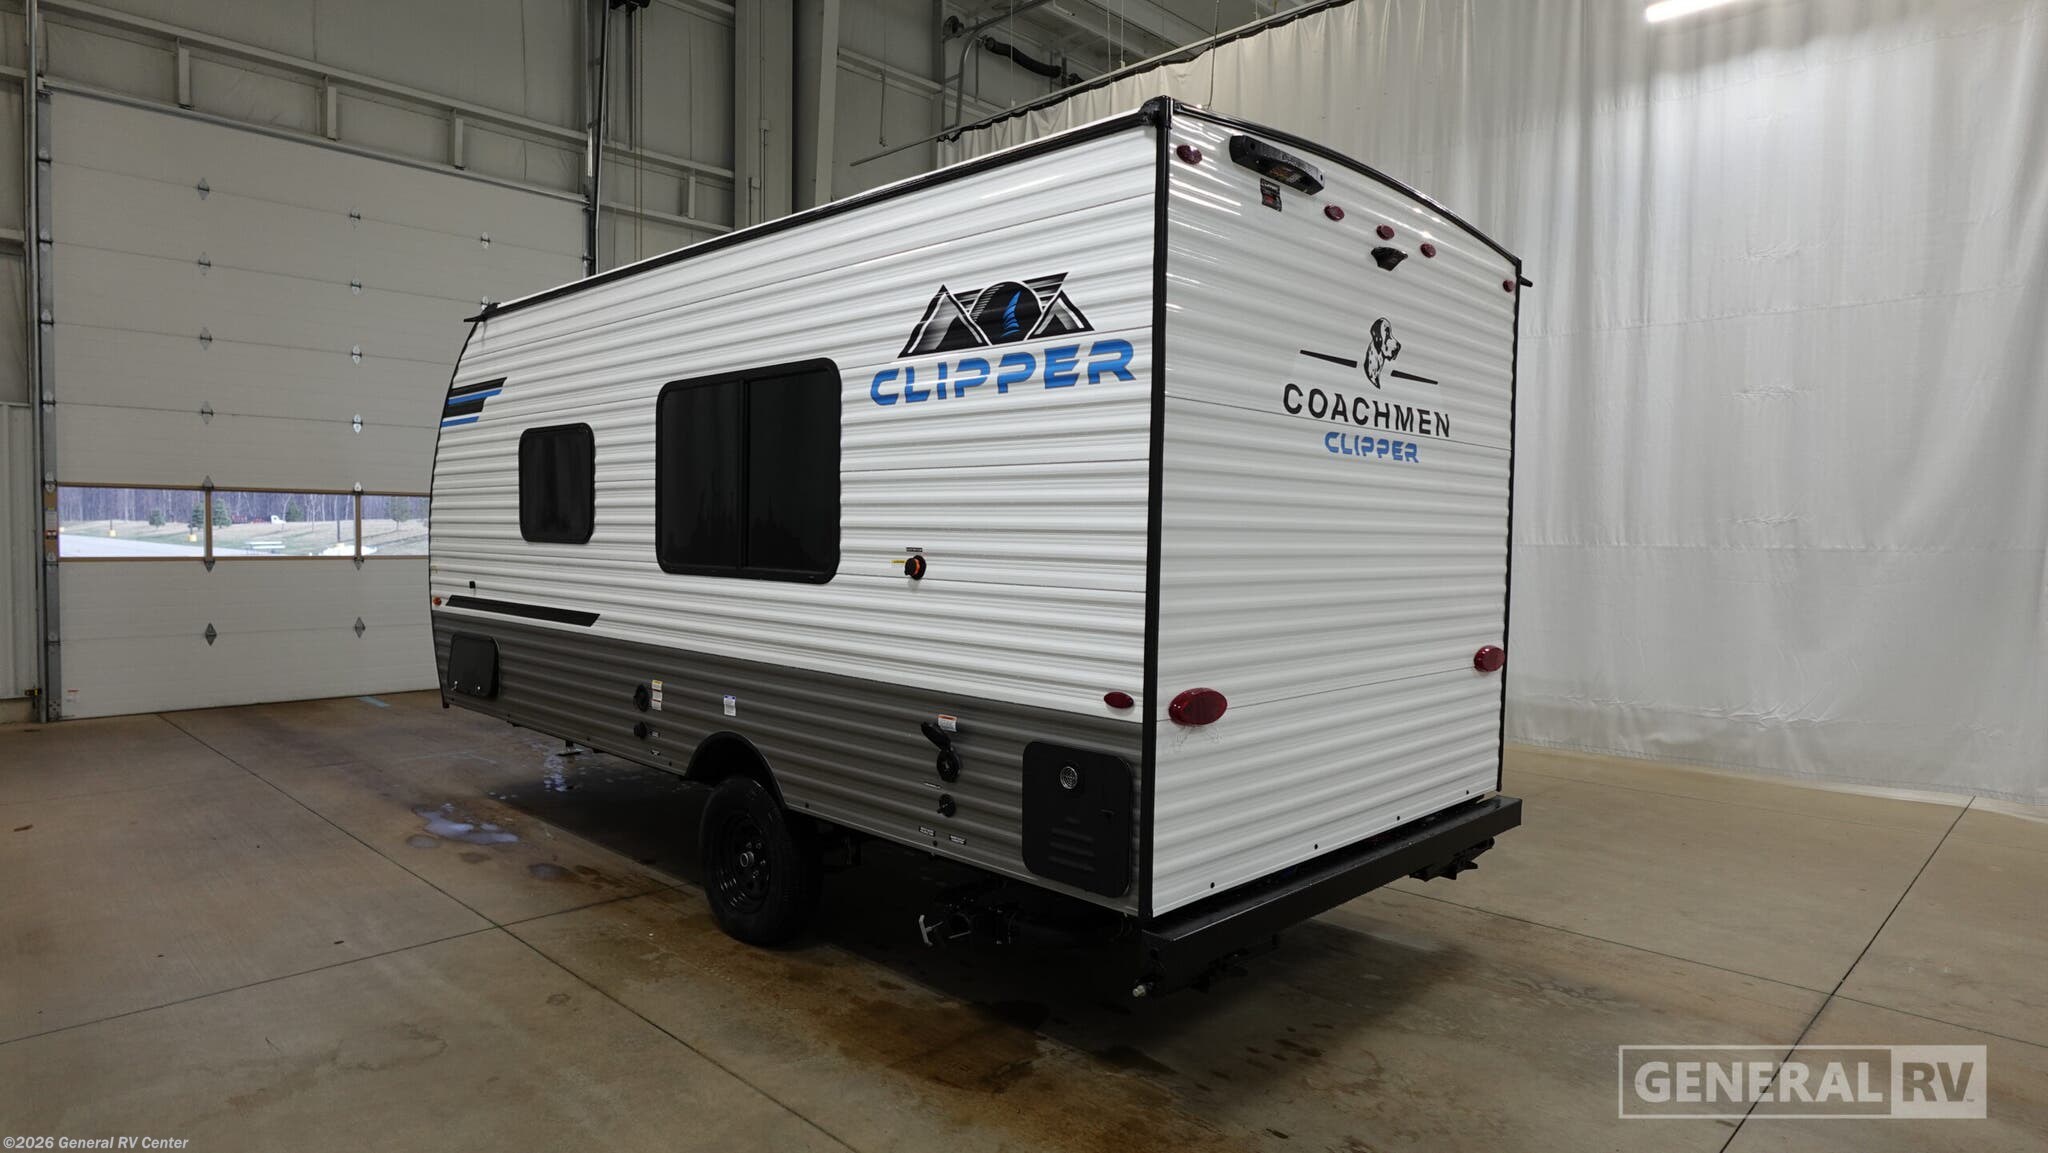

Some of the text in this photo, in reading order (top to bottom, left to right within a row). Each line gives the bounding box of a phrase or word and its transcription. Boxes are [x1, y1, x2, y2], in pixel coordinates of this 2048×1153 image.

[870, 339, 1136, 406] CLIPPER
[1283, 383, 1450, 438] COACHMEN
[1324, 431, 1419, 463] CLIPPER
